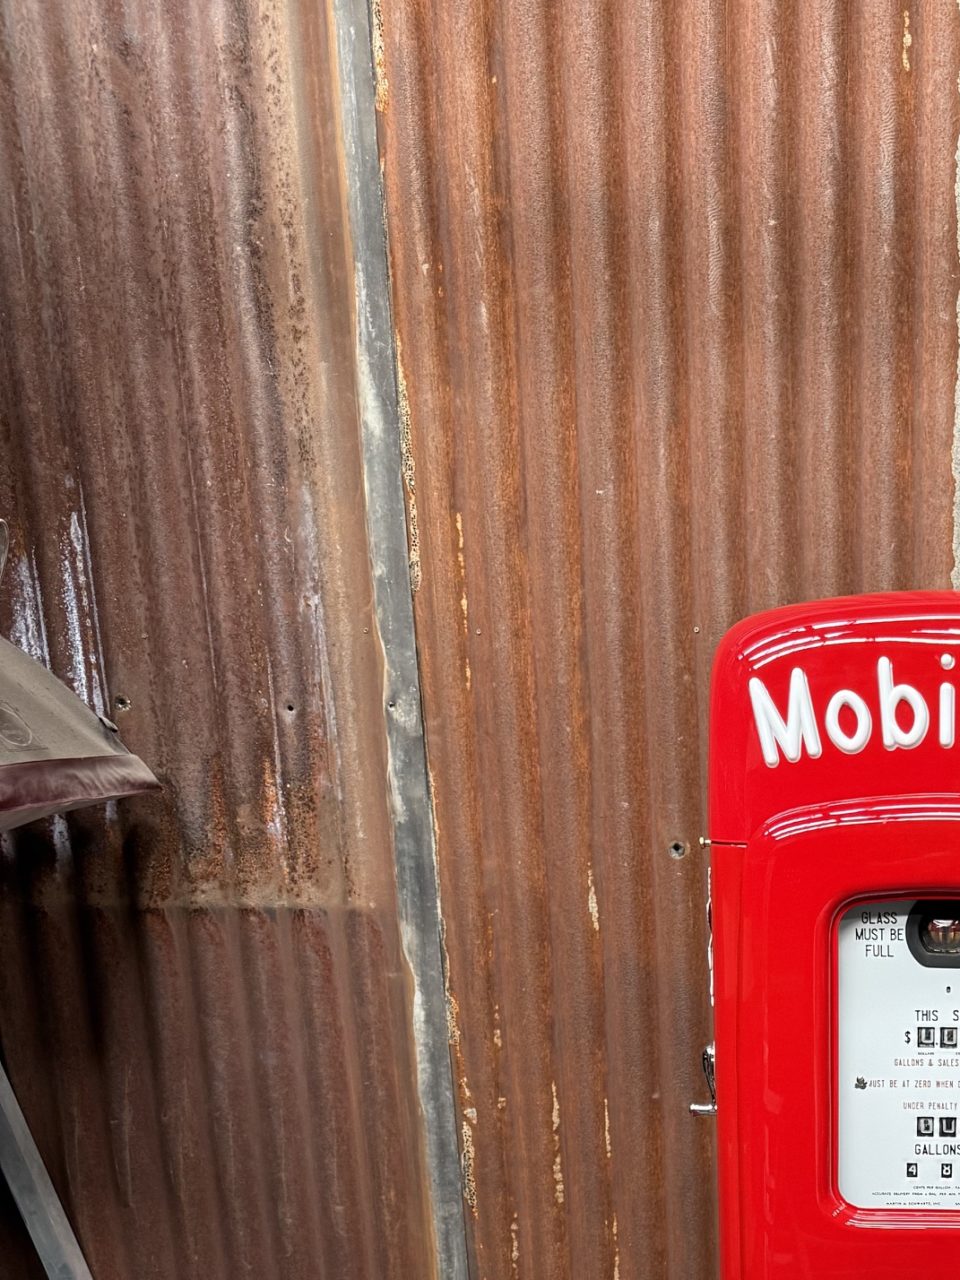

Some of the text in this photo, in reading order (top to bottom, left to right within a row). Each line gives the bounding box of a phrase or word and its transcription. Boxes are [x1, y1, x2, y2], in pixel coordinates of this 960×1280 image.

[861, 911, 898, 925] GLASS
[855, 928, 905, 941] MUST BE
[865, 944, 895, 958] FULL
[914, 1009, 939, 1022] THIS
[893, 1058, 925, 1067] GALLONS
[938, 1058, 960, 1067] SALES
[889, 1079, 898, 1088] BE
[902, 1079, 910, 1088] AT
[914, 1079, 932, 1088] ZERO
[936, 1079, 954, 1088] WHEN
[902, 1101, 925, 1110] UNDER
[928, 1101, 958, 1110] PENALTY
